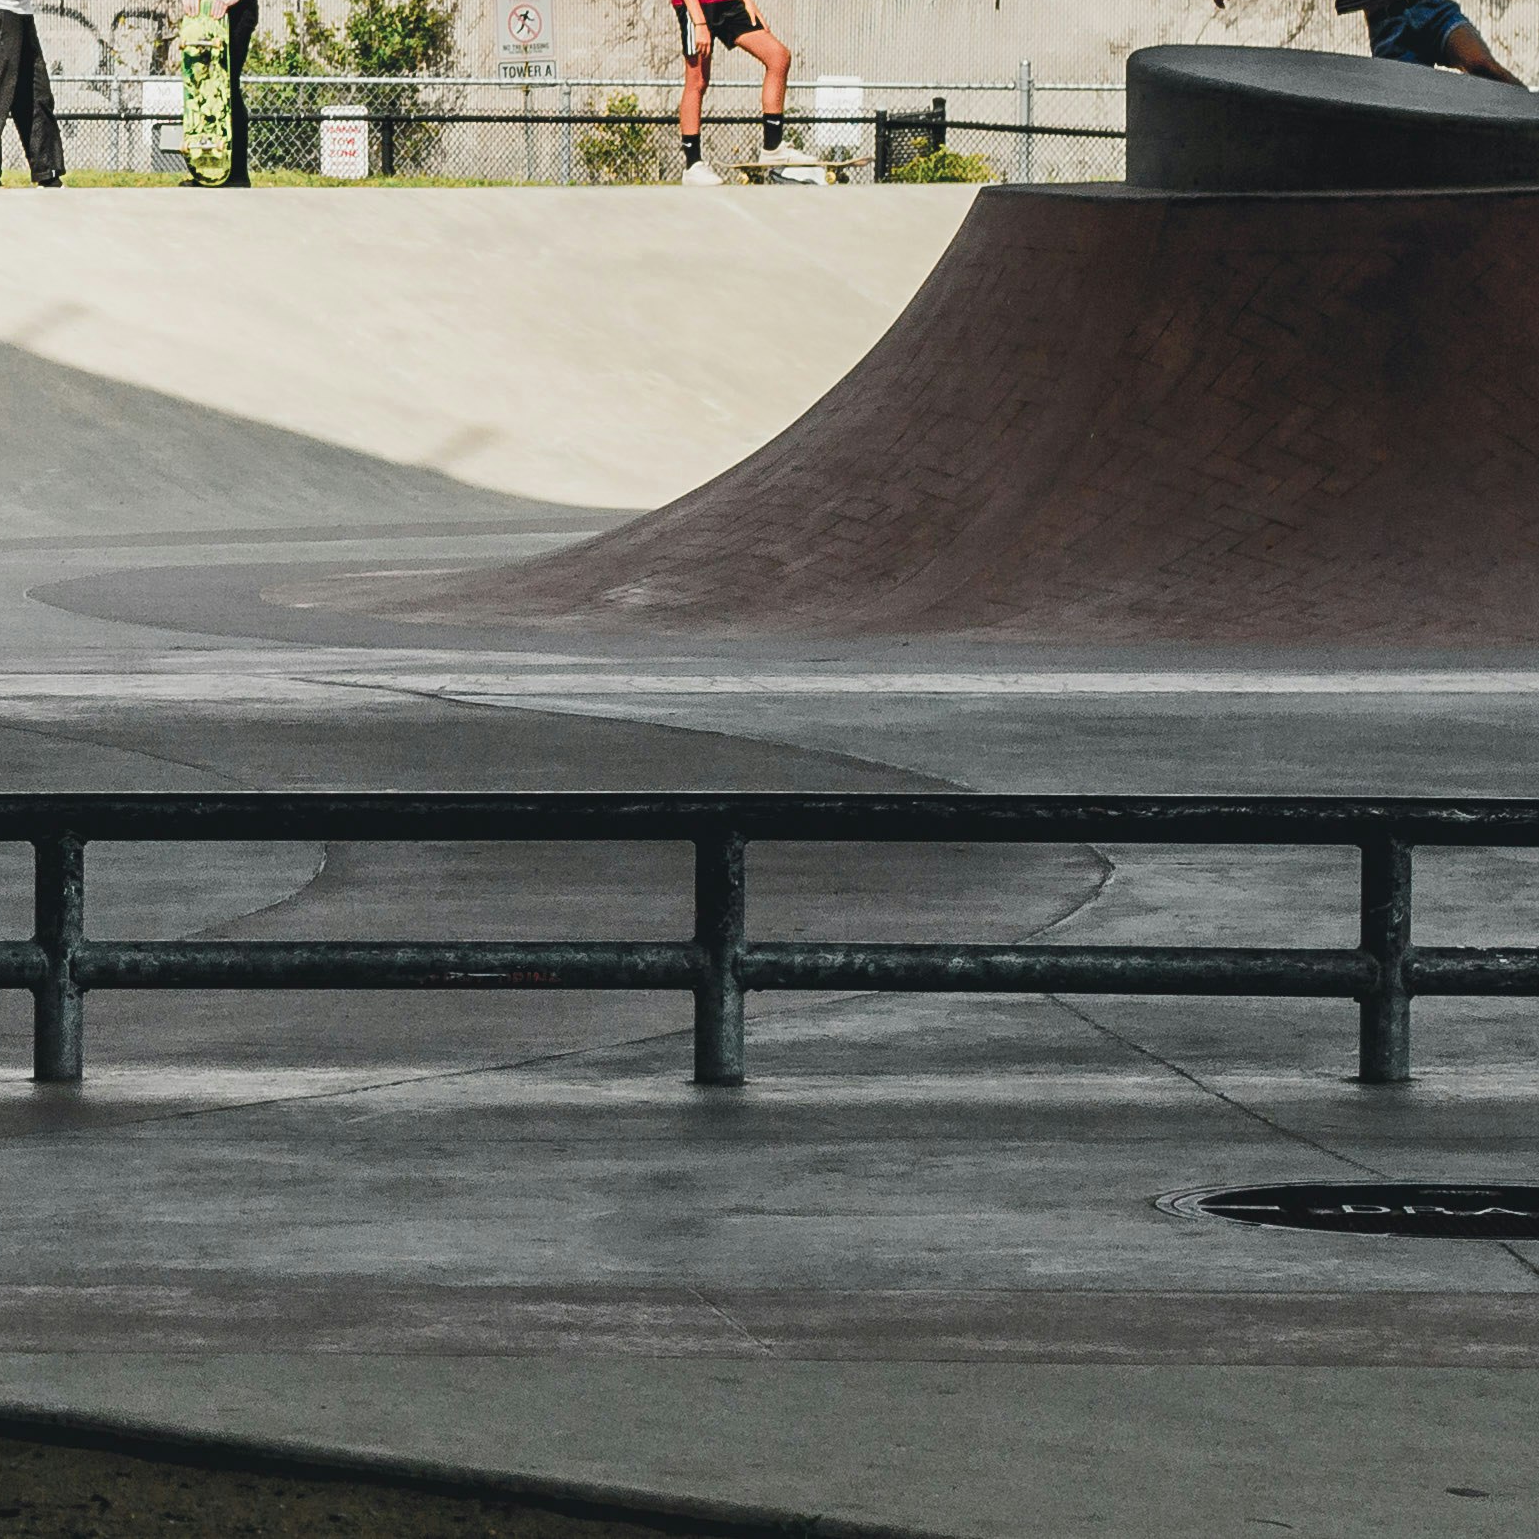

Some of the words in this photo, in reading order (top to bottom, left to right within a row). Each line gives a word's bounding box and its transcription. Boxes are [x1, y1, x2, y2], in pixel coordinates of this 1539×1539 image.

[512, 42, 549, 50] TREASSING
[502, 64, 542, 78] TOWER
[545, 64, 553, 77] A
